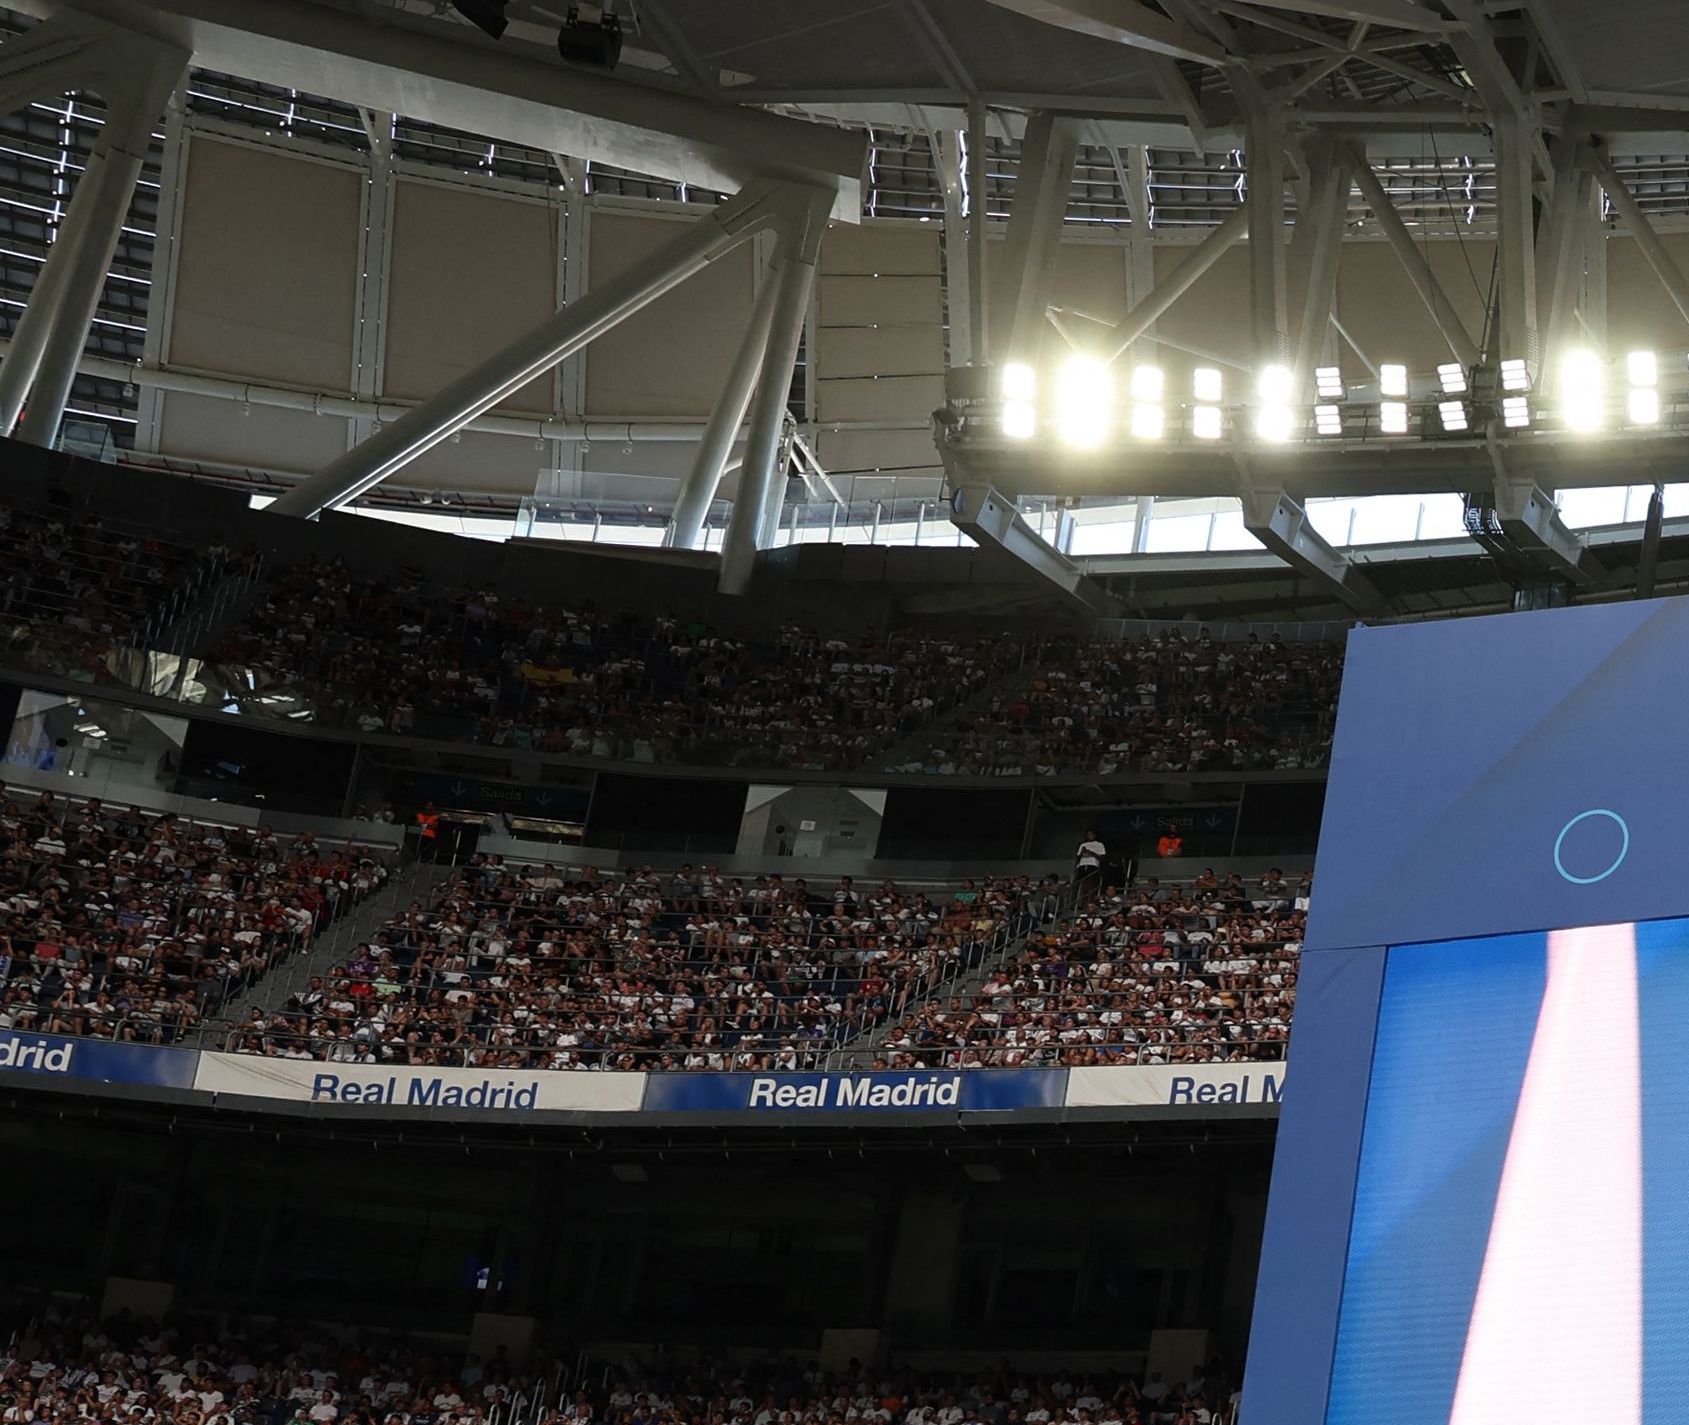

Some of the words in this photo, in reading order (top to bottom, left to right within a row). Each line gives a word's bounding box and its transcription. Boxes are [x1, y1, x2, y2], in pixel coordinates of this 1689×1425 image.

[312, 1073, 397, 1103] Real
[408, 1076, 539, 1111] Madrid
[749, 1077, 828, 1108] Real
[834, 1076, 961, 1107] Madrid
[1170, 1075, 1250, 1104] Real
